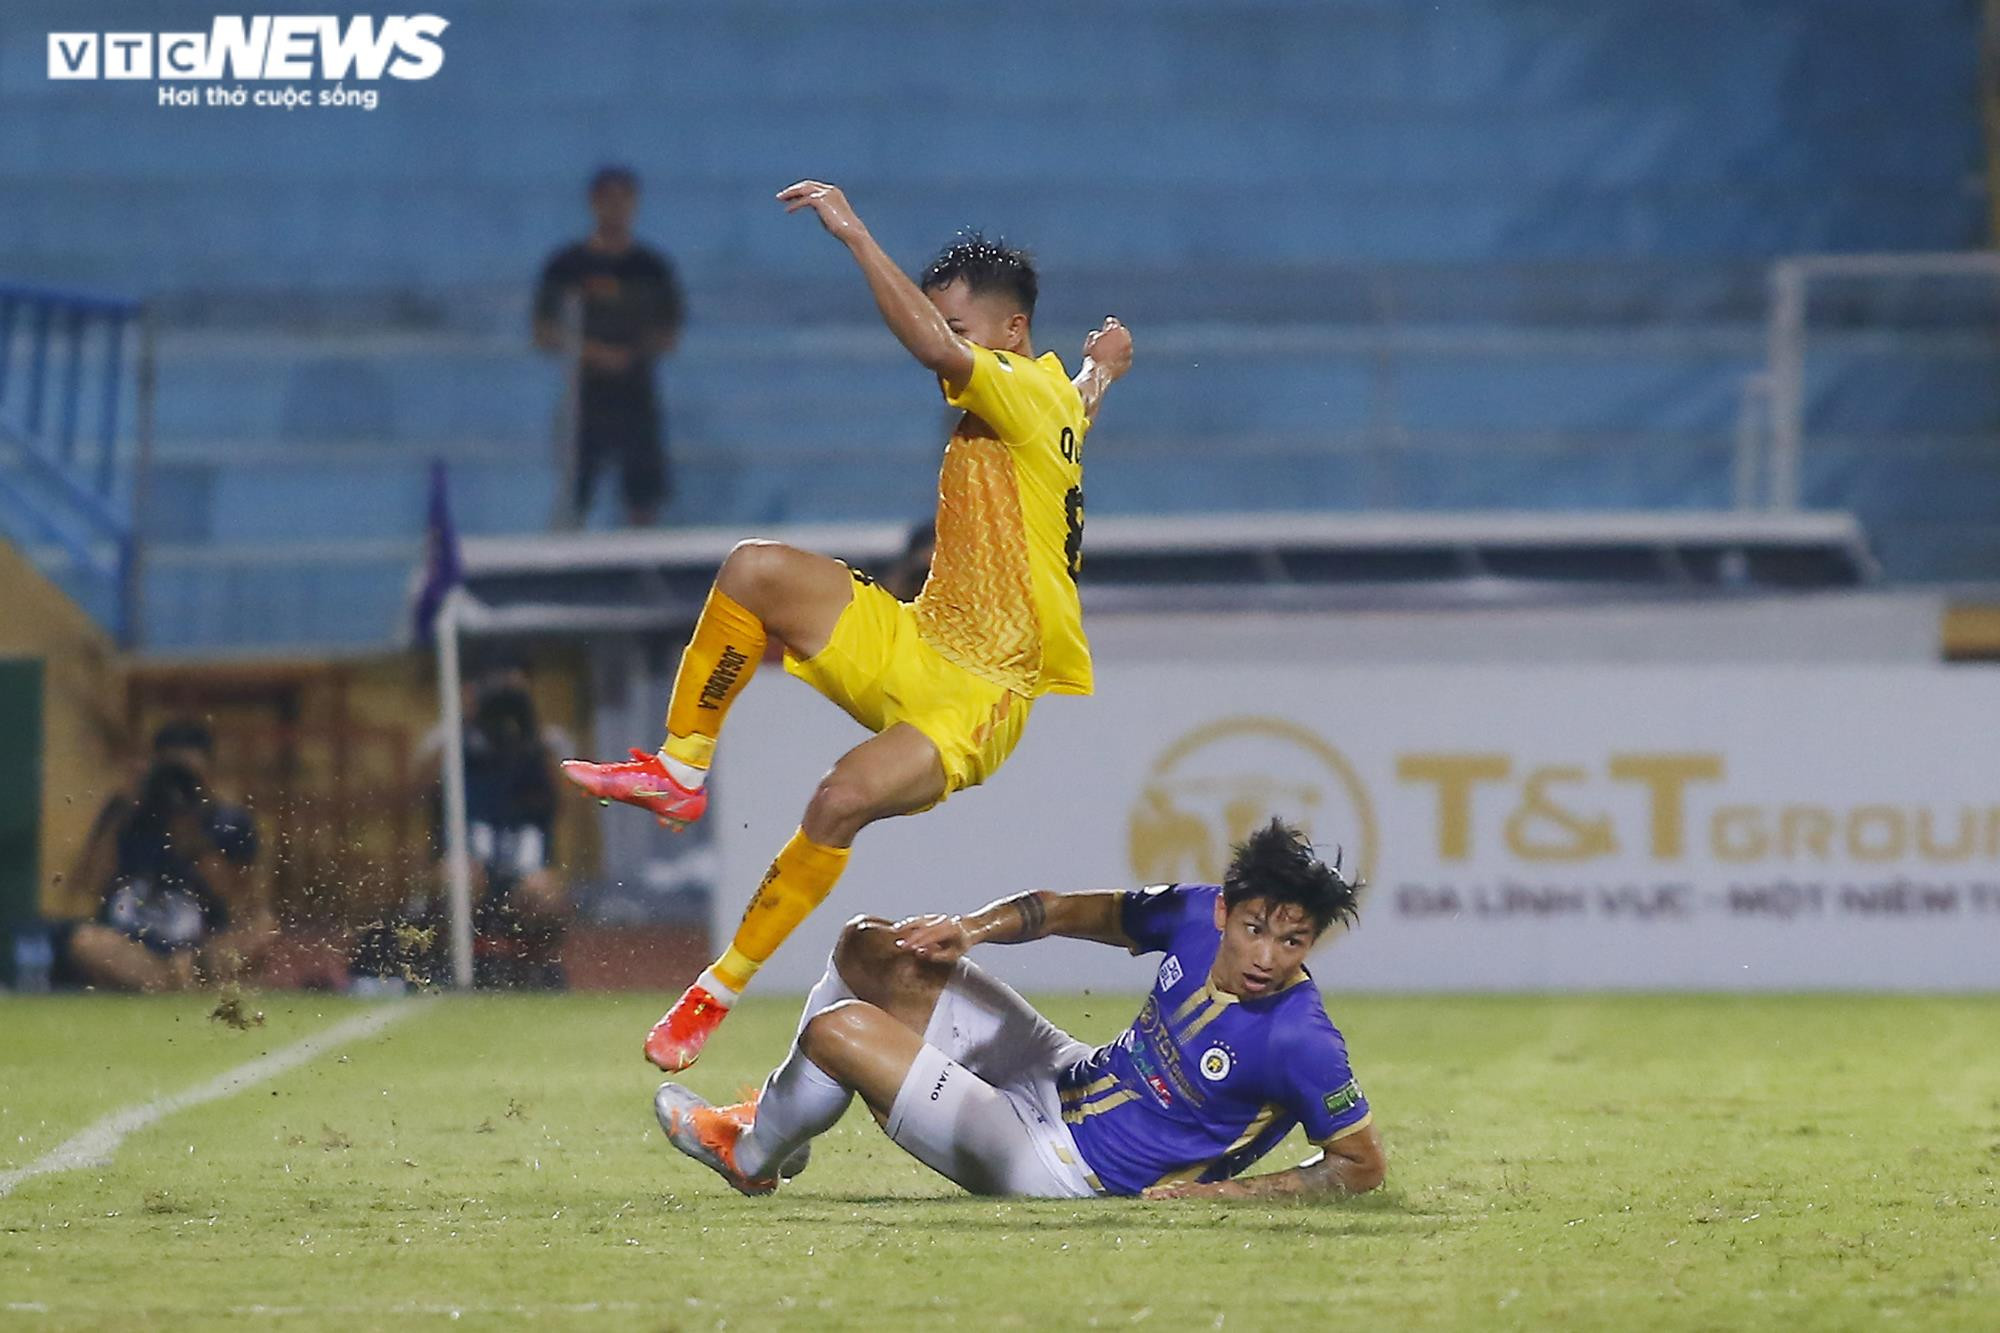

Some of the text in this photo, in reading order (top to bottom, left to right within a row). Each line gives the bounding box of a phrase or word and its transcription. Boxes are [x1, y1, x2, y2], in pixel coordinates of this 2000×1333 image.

[1395, 752, 2000, 863] T&T GROU
[930, 1070, 950, 1101] JAKO
